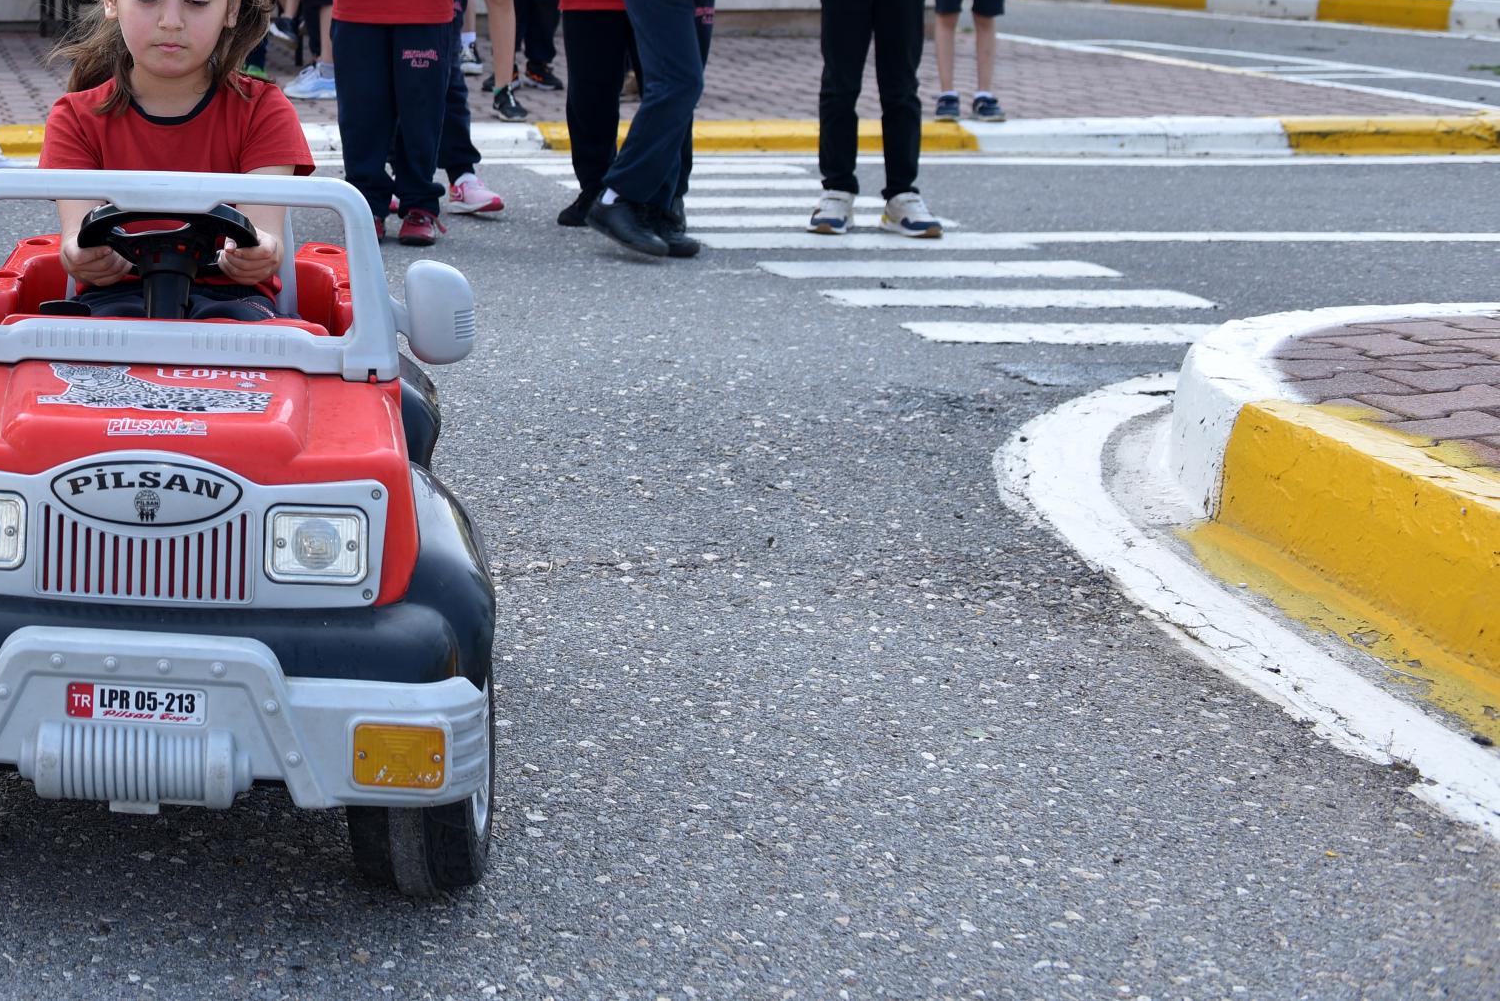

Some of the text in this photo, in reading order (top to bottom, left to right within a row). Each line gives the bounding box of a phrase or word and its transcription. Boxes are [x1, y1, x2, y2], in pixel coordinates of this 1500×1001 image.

[109, 418, 180, 433] PİLSAN
[67, 469, 225, 500] PİLSAN
[72, 693, 91, 708] TR
[100, 688, 196, 714] LPR 05-213
